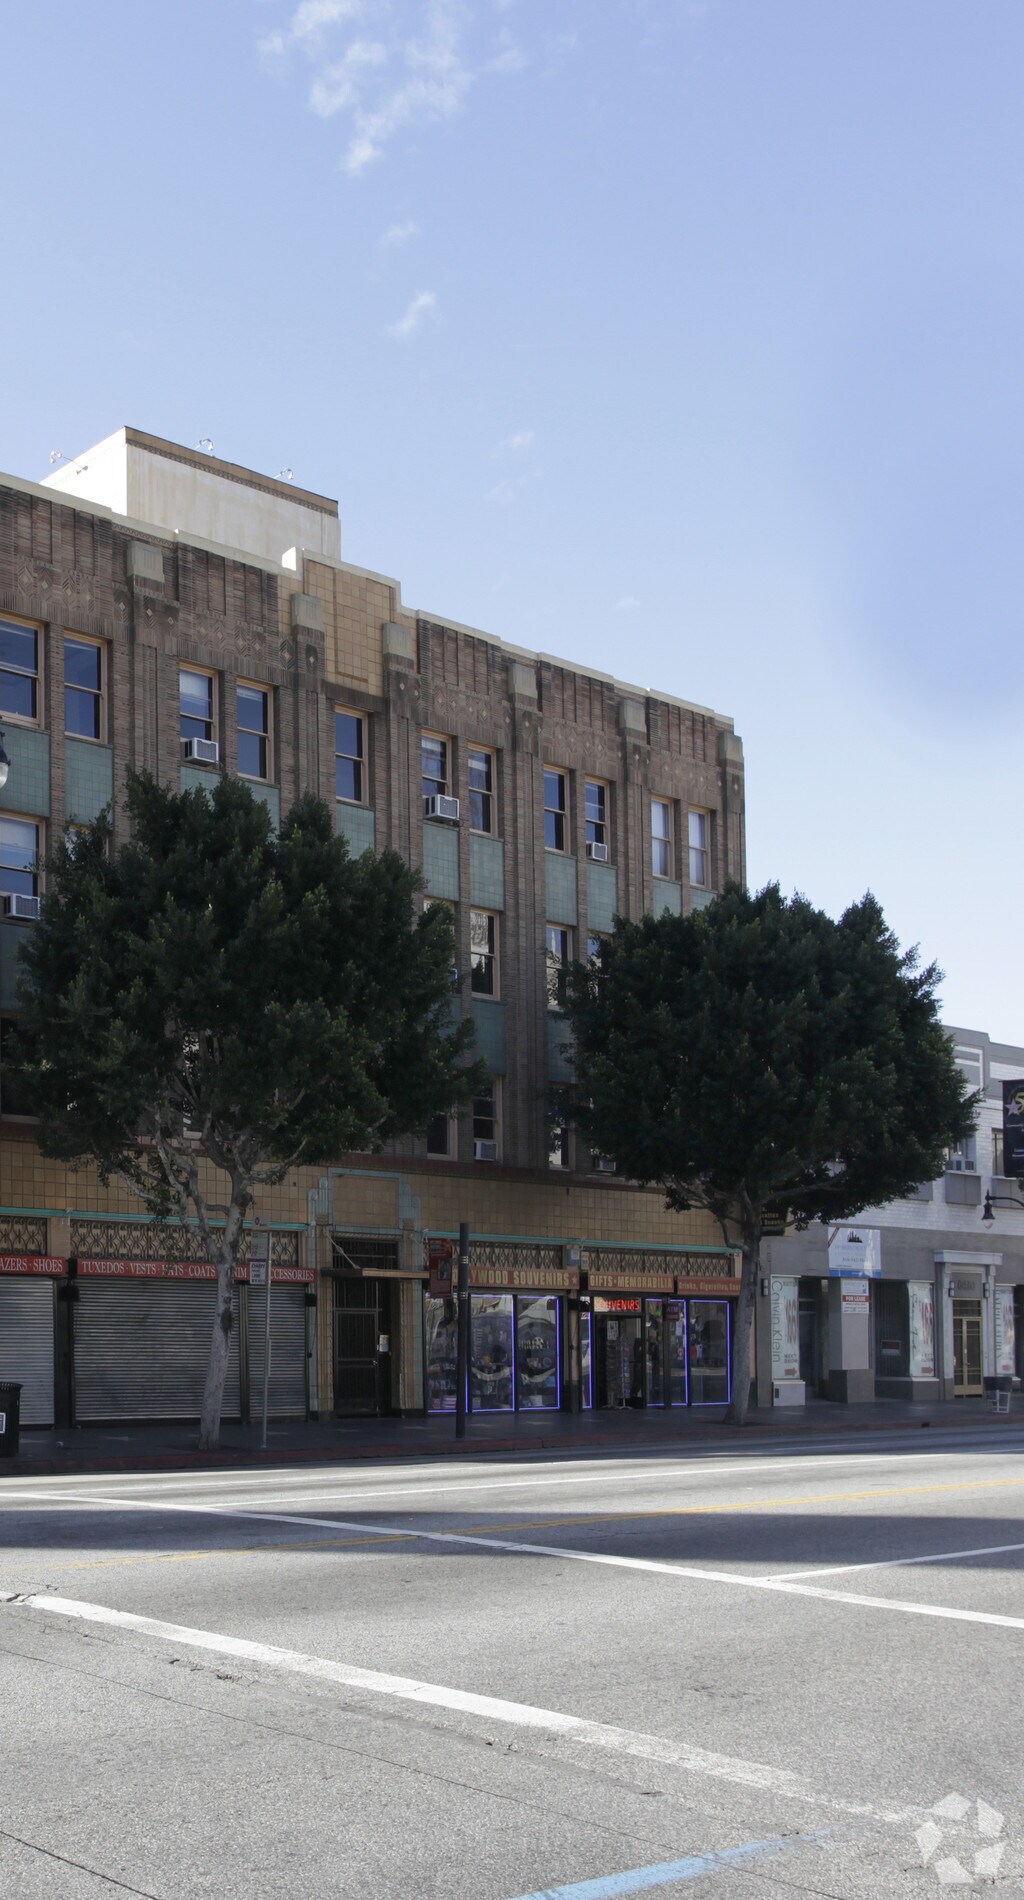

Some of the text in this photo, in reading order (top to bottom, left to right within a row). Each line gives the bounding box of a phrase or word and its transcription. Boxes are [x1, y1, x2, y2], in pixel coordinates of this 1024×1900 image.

[33, 1258, 63, 1272] SHOES
[82, 1261, 125, 1274] TUXEDOS
[130, 1262, 156, 1275] VESTS
[188, 1265, 216, 1277] COATS
[233, 1266, 247, 1278] NIM
[452, 1269, 570, 1286] OYWOOD SOUVENIRS
[589, 1275, 673, 1289] GIFTS MEMORABILIA
[772, 1280, 783, 1363] Calvin Klein
